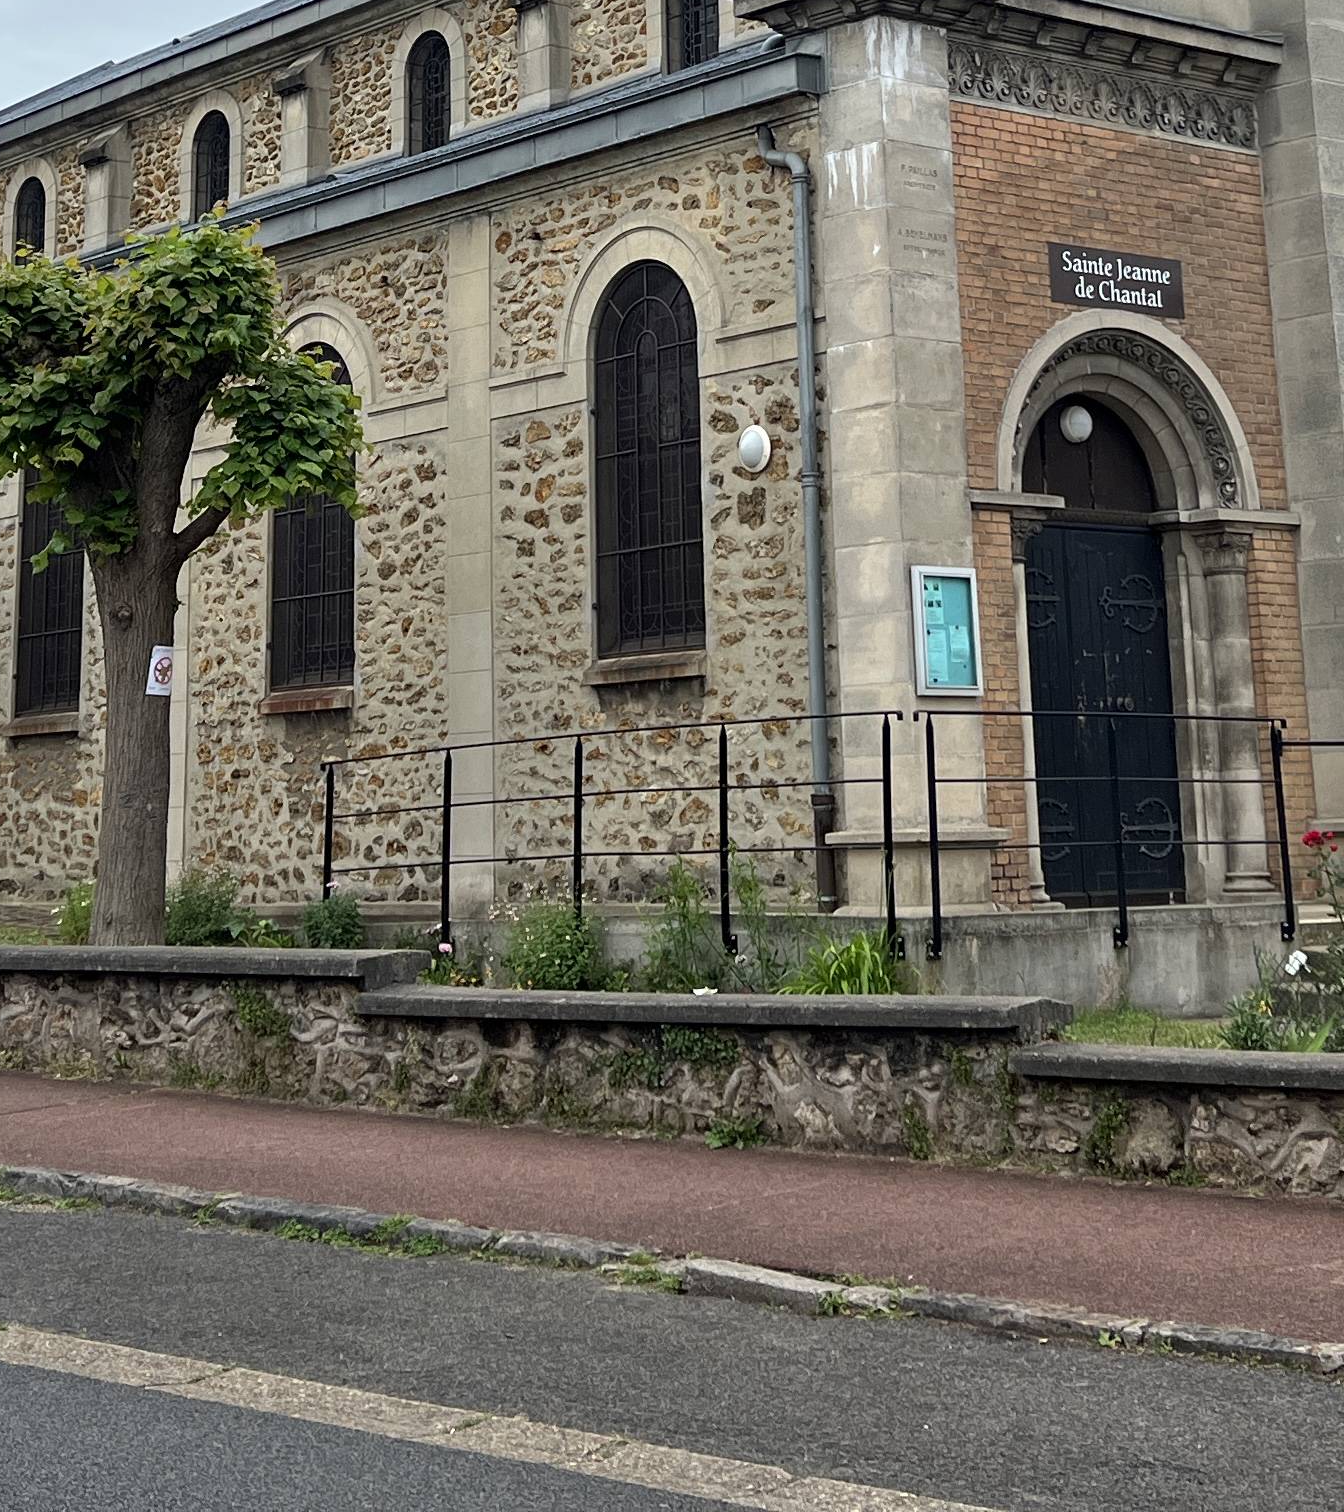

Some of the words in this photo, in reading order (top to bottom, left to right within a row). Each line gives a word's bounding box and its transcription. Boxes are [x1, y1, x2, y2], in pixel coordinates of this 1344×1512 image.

[1062, 250, 1113, 276] Sainte
[1116, 258, 1171, 285] Jeanne
[1075, 276, 1095, 299] de
[1098, 280, 1163, 308] Chantal
